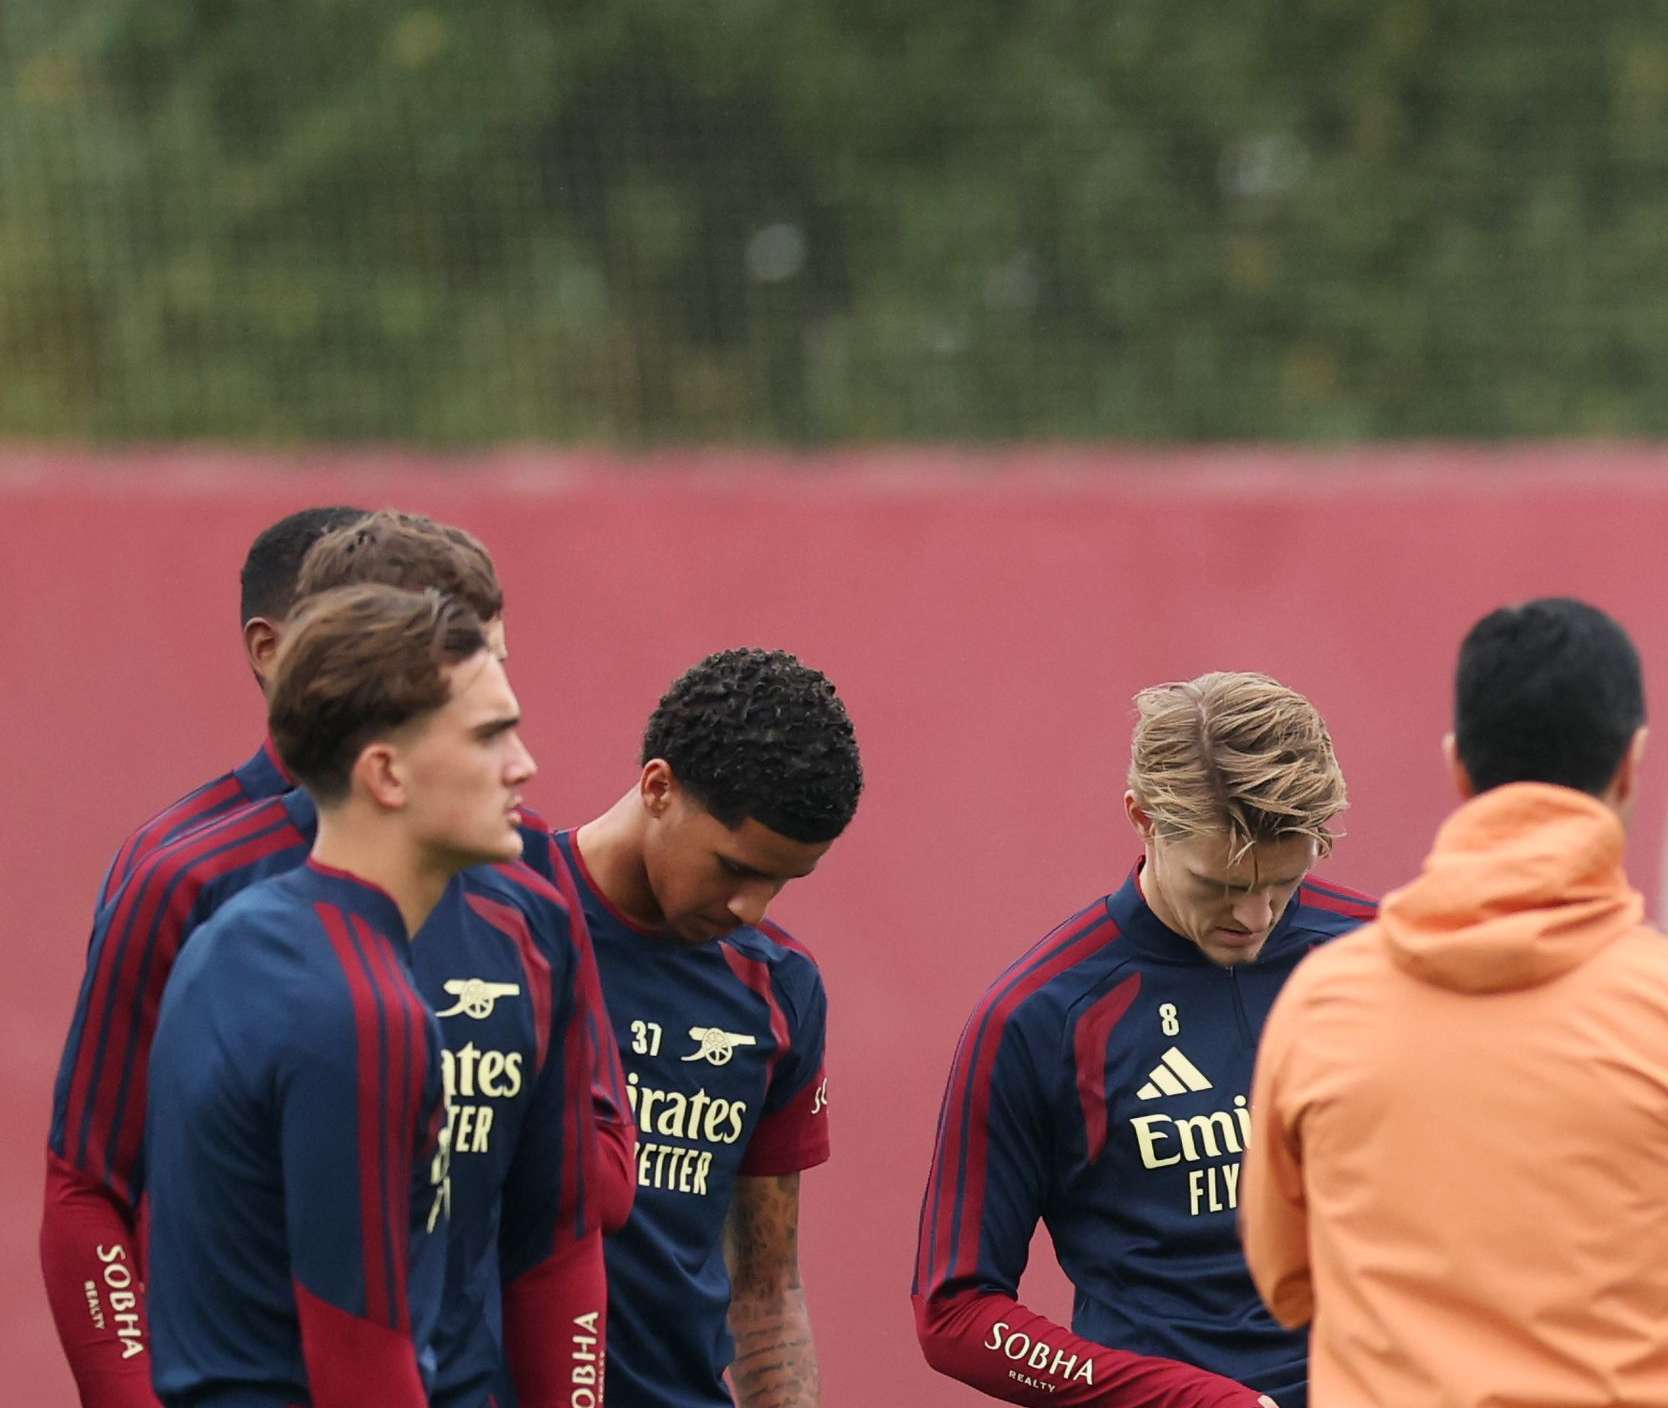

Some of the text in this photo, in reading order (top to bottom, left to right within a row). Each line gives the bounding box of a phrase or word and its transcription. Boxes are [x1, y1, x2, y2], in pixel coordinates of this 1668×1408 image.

[631, 1020, 662, 1056] 37
[1159, 1003, 1179, 1036] 8
[636, 1143, 712, 1195] ETTER
[1189, 1164, 1240, 1216] FLY
[97, 1245, 144, 1359] SOBHA
[984, 1322, 1093, 1385] SOBHA
[1008, 1370, 1056, 1393] REALTY
